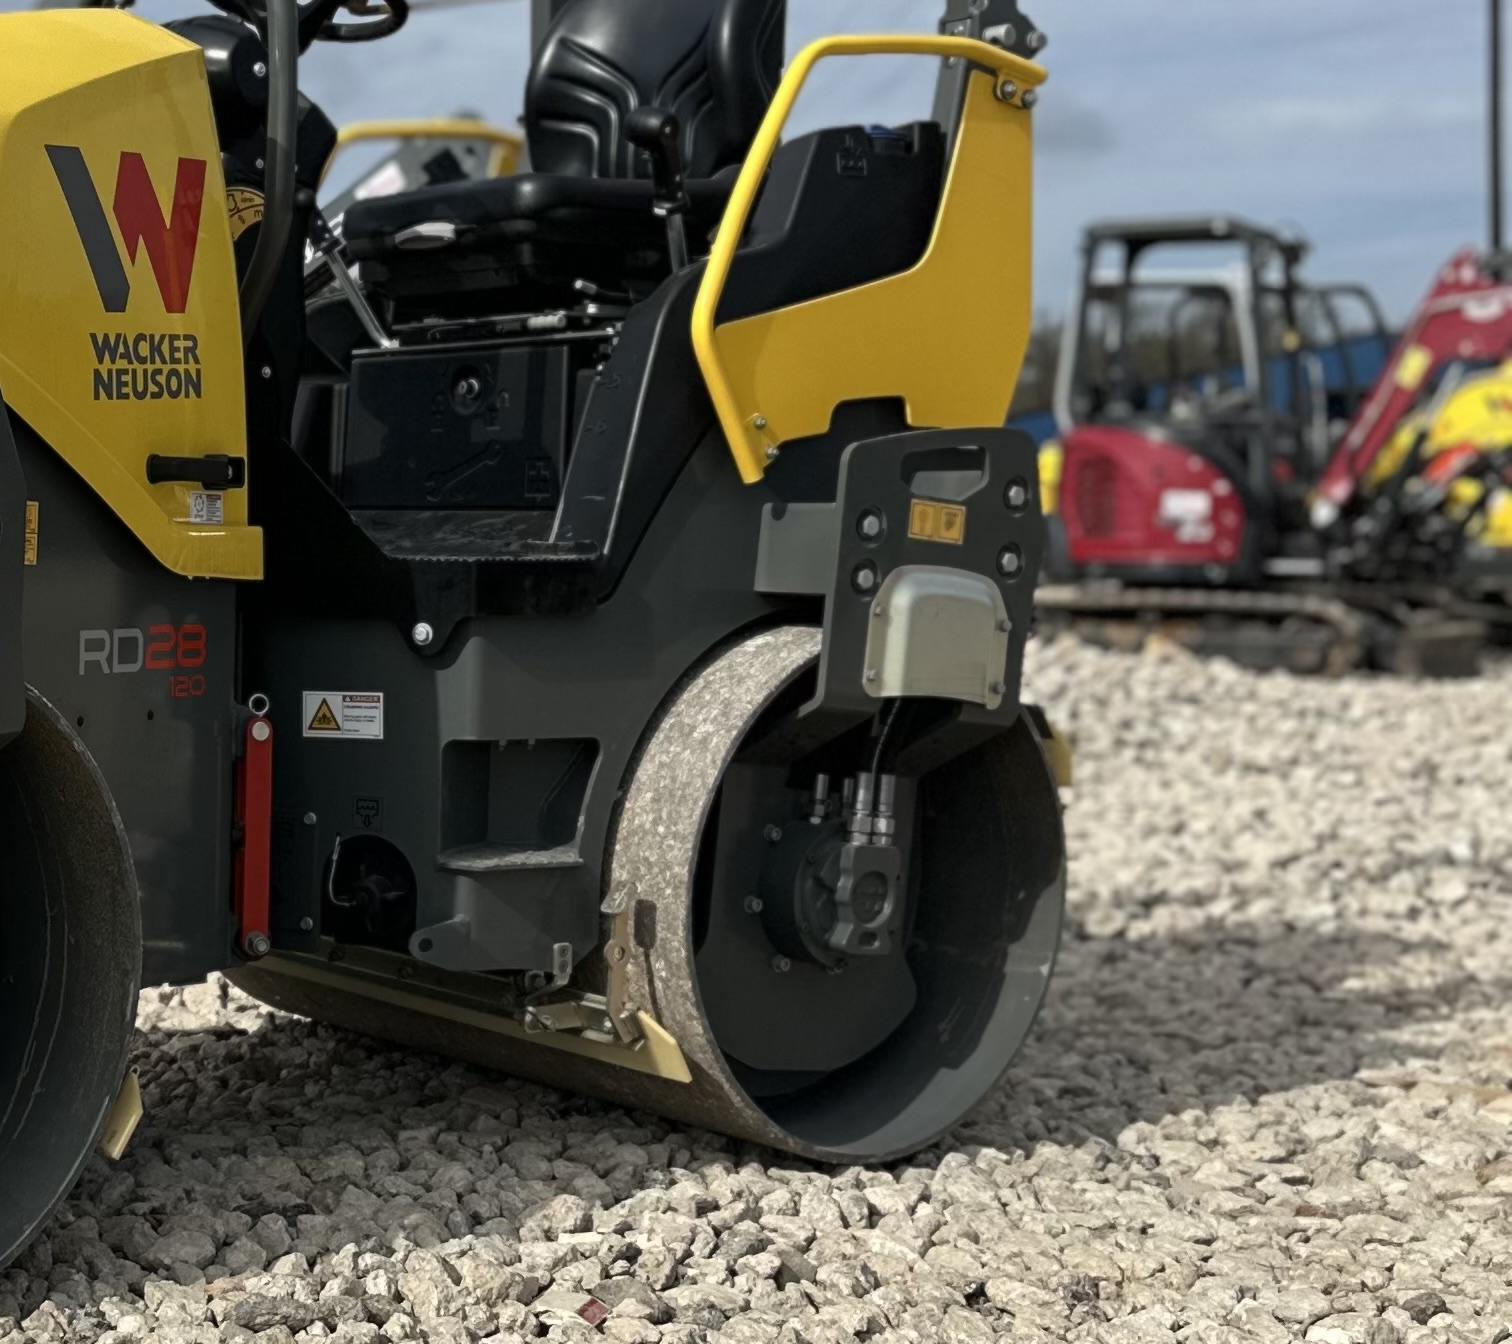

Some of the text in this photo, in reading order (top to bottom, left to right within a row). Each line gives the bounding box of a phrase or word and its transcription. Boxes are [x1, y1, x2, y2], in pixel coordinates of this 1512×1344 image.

[89, 332, 201, 365] WACKER
[93, 368, 202, 400] NEUSON
[79, 623, 207, 675] RD28
[169, 674, 206, 697] 120
